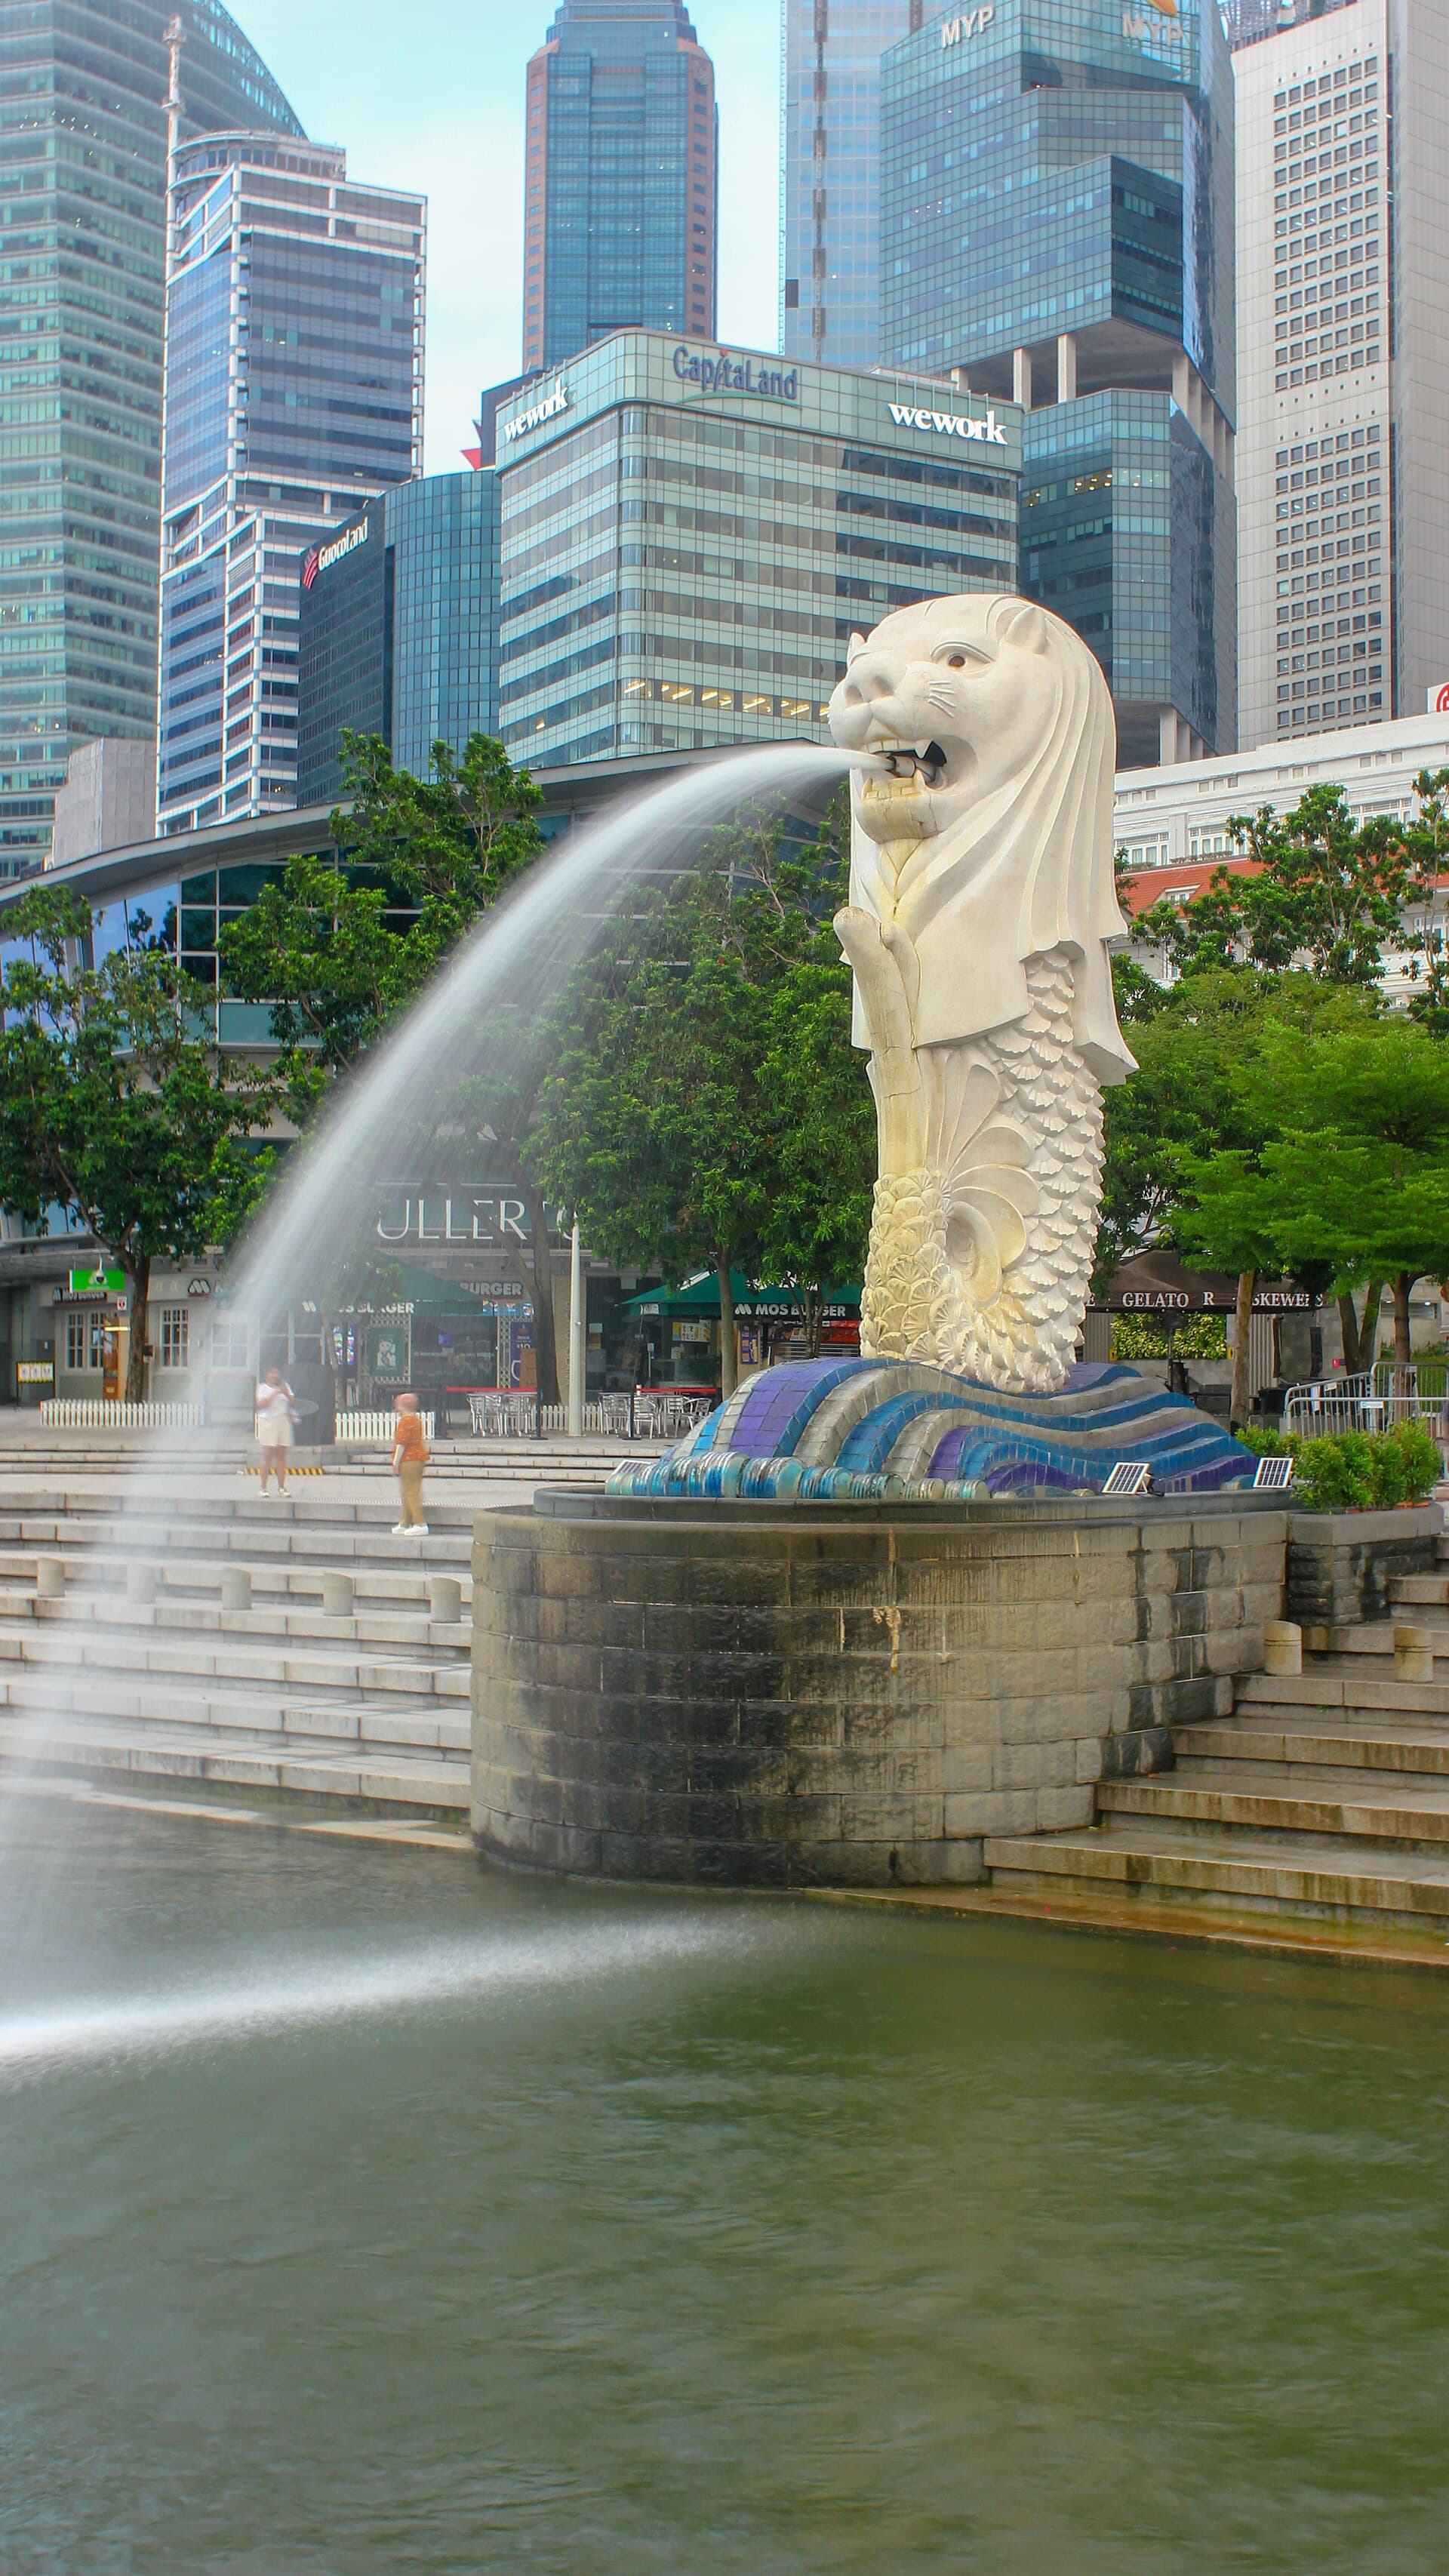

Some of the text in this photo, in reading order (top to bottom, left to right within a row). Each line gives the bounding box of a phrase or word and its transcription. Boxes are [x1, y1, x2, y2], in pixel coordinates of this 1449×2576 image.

[941, 5, 995, 49] MYP
[1121, 12, 1183, 46] MYP
[672, 345, 798, 400] CapitaLand
[503, 377, 568, 444] wework
[888, 402, 1008, 445] wework
[318, 516, 368, 571] GuocoLand
[755, 1303, 789, 1316] MOS
[1121, 1291, 1190, 1307] GELATO
